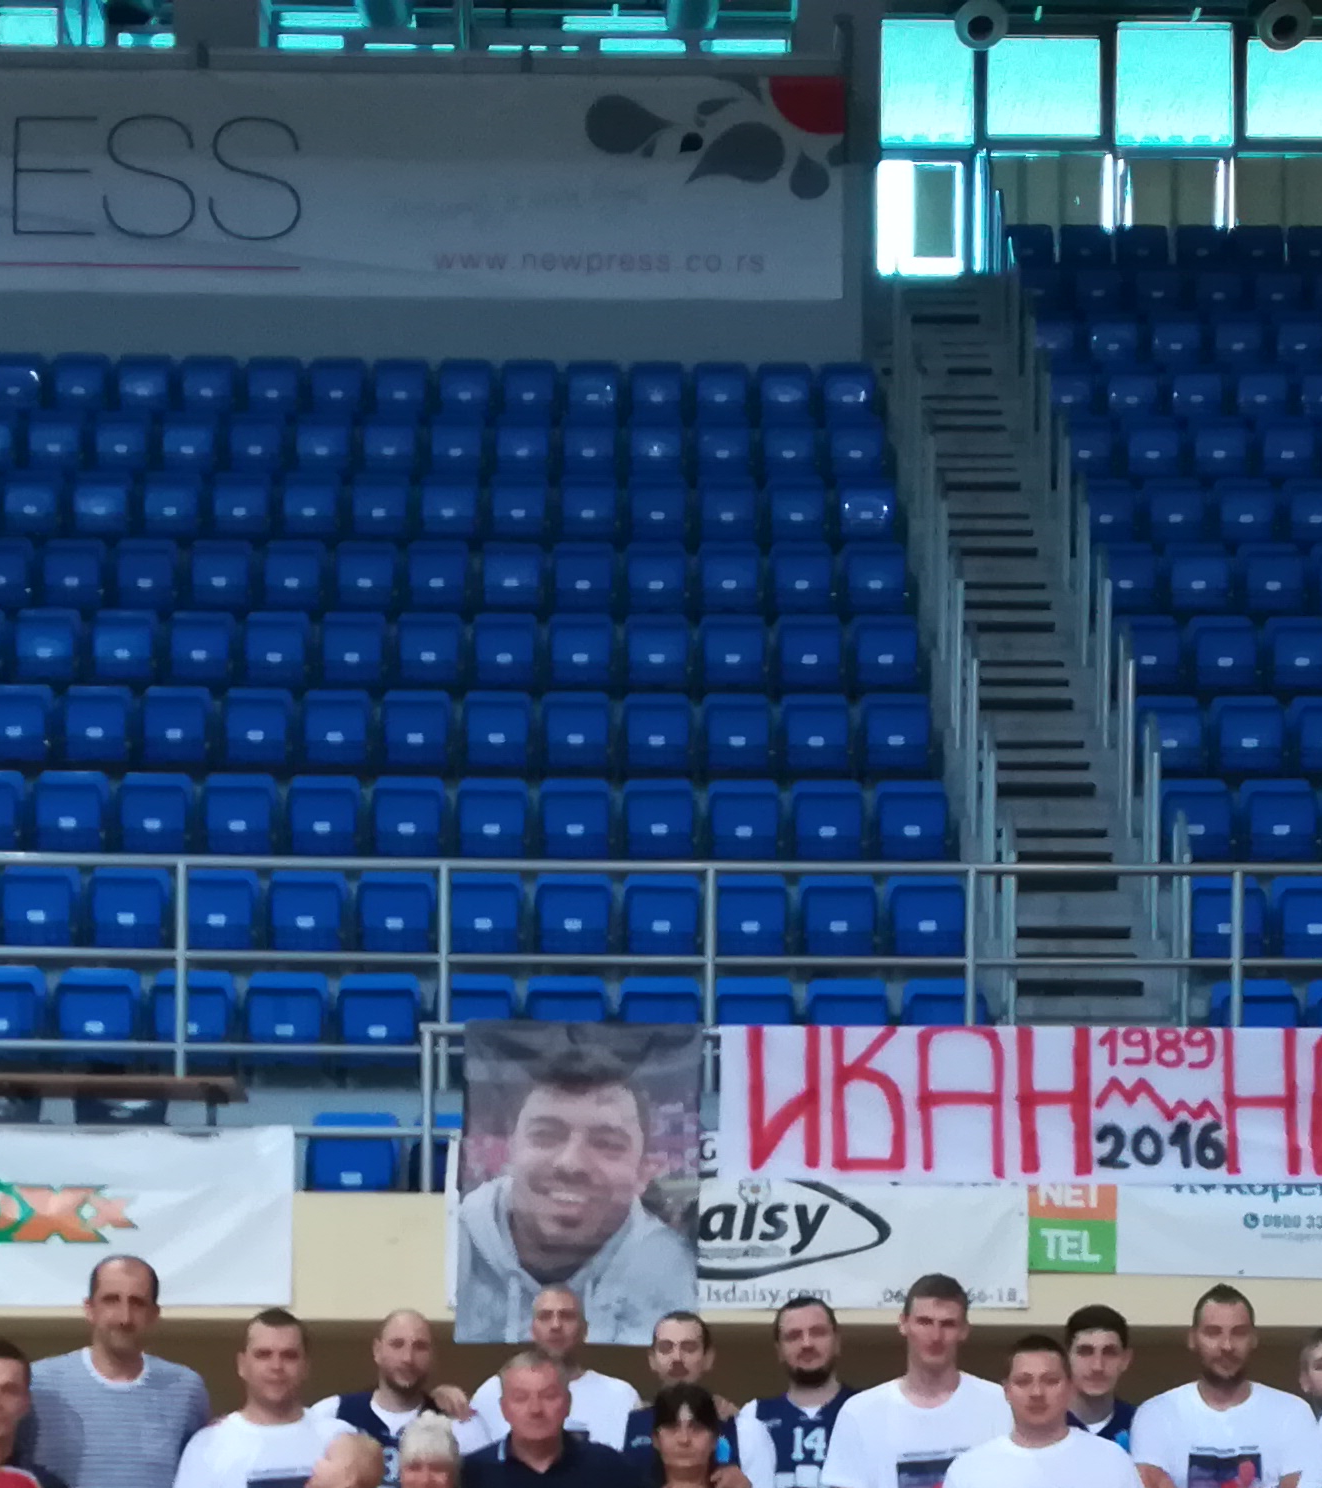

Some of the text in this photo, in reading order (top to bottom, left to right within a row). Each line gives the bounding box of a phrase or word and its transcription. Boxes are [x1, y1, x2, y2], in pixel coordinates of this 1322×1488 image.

[1098, 1028, 1216, 1069] 1989
[1096, 1121, 1226, 1169] 2016
[1040, 1228, 1102, 1263] TEL
[791, 1426, 827, 1462] 14
